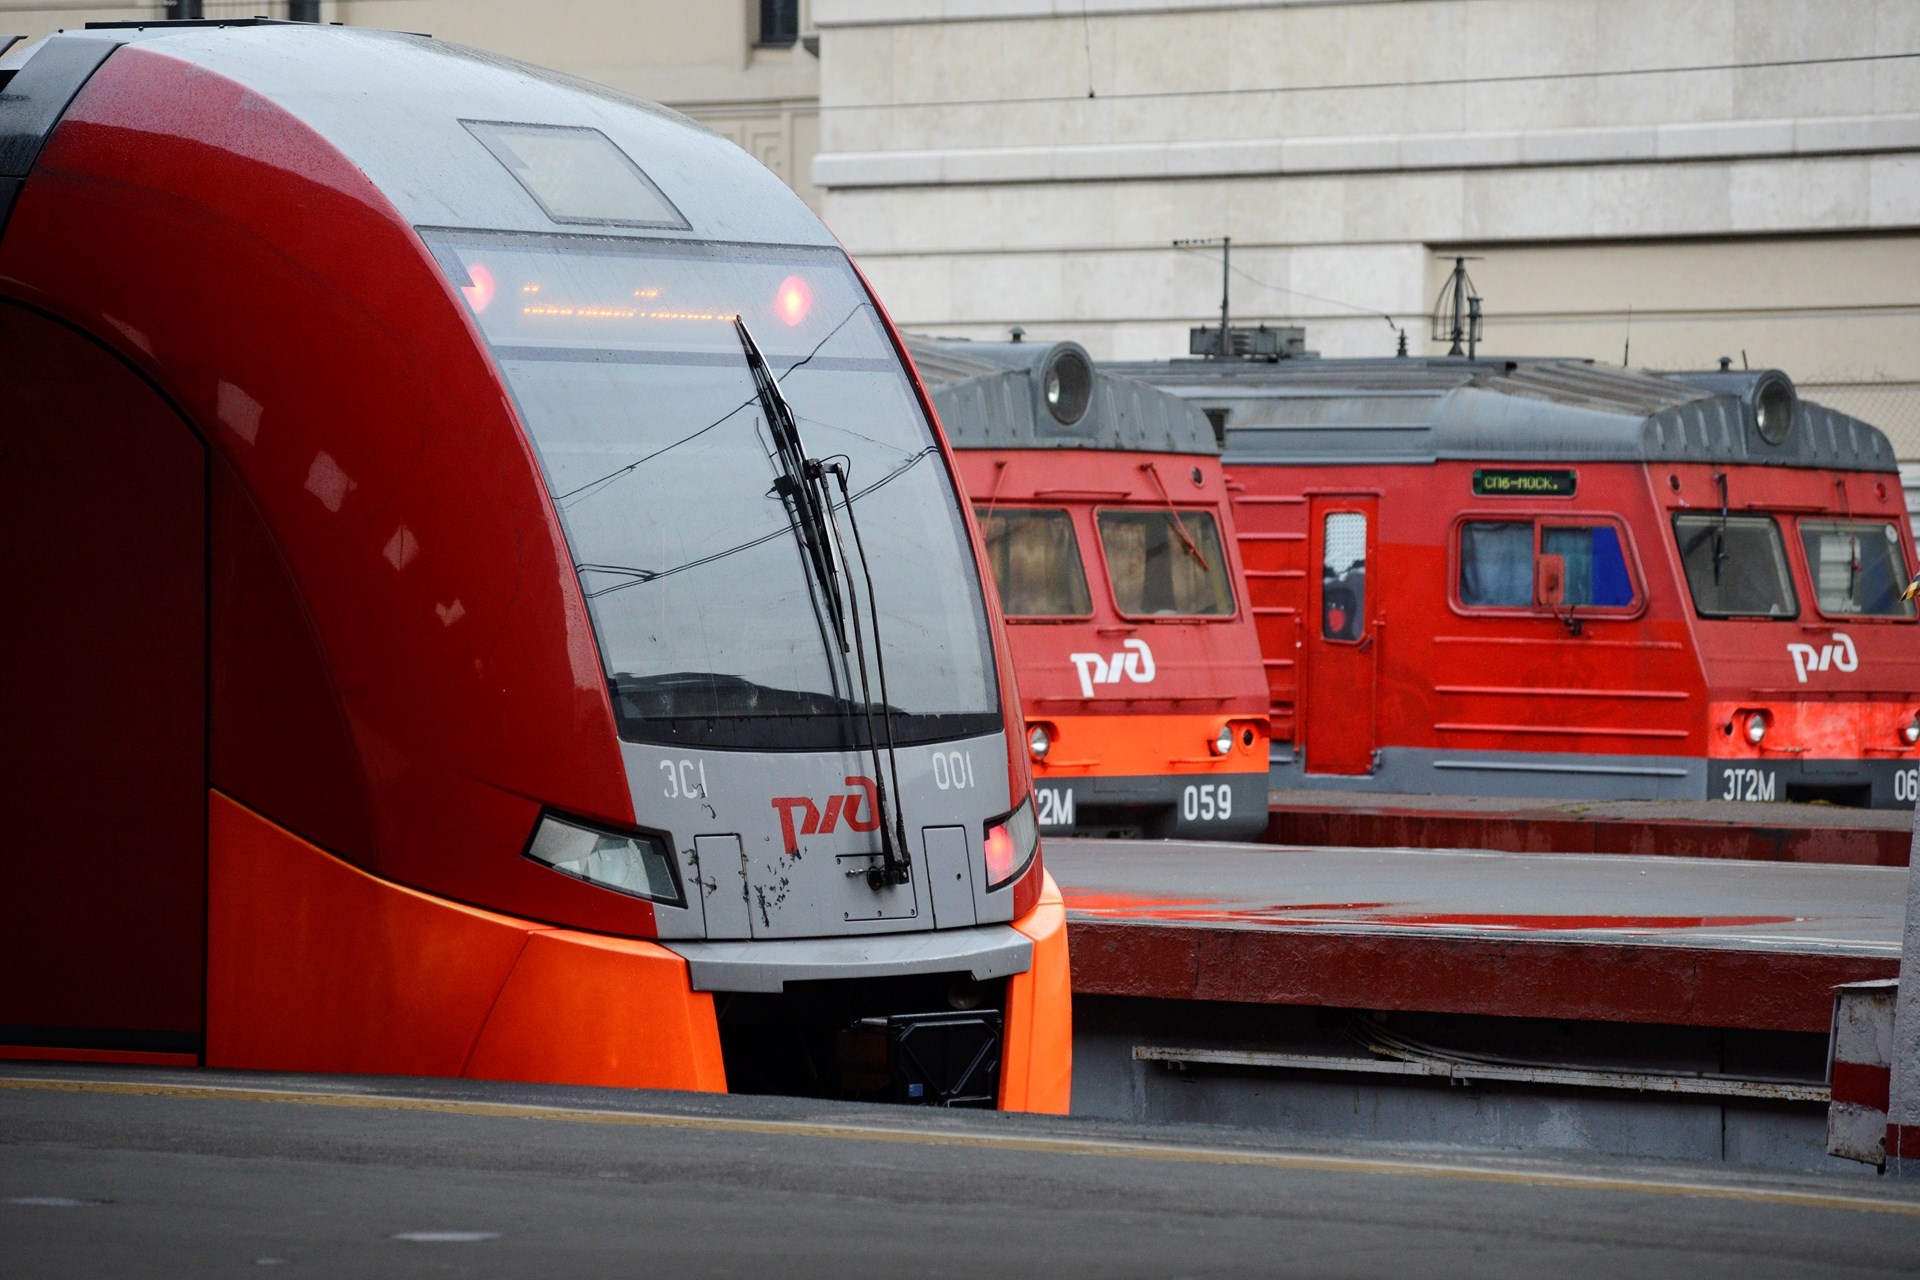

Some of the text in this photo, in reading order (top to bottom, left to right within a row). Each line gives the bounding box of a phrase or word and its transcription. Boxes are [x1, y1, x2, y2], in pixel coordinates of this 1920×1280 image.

[932, 751, 975, 790] 001
[1035, 788, 1073, 825] 2М
[1183, 784, 1232, 821] 059
